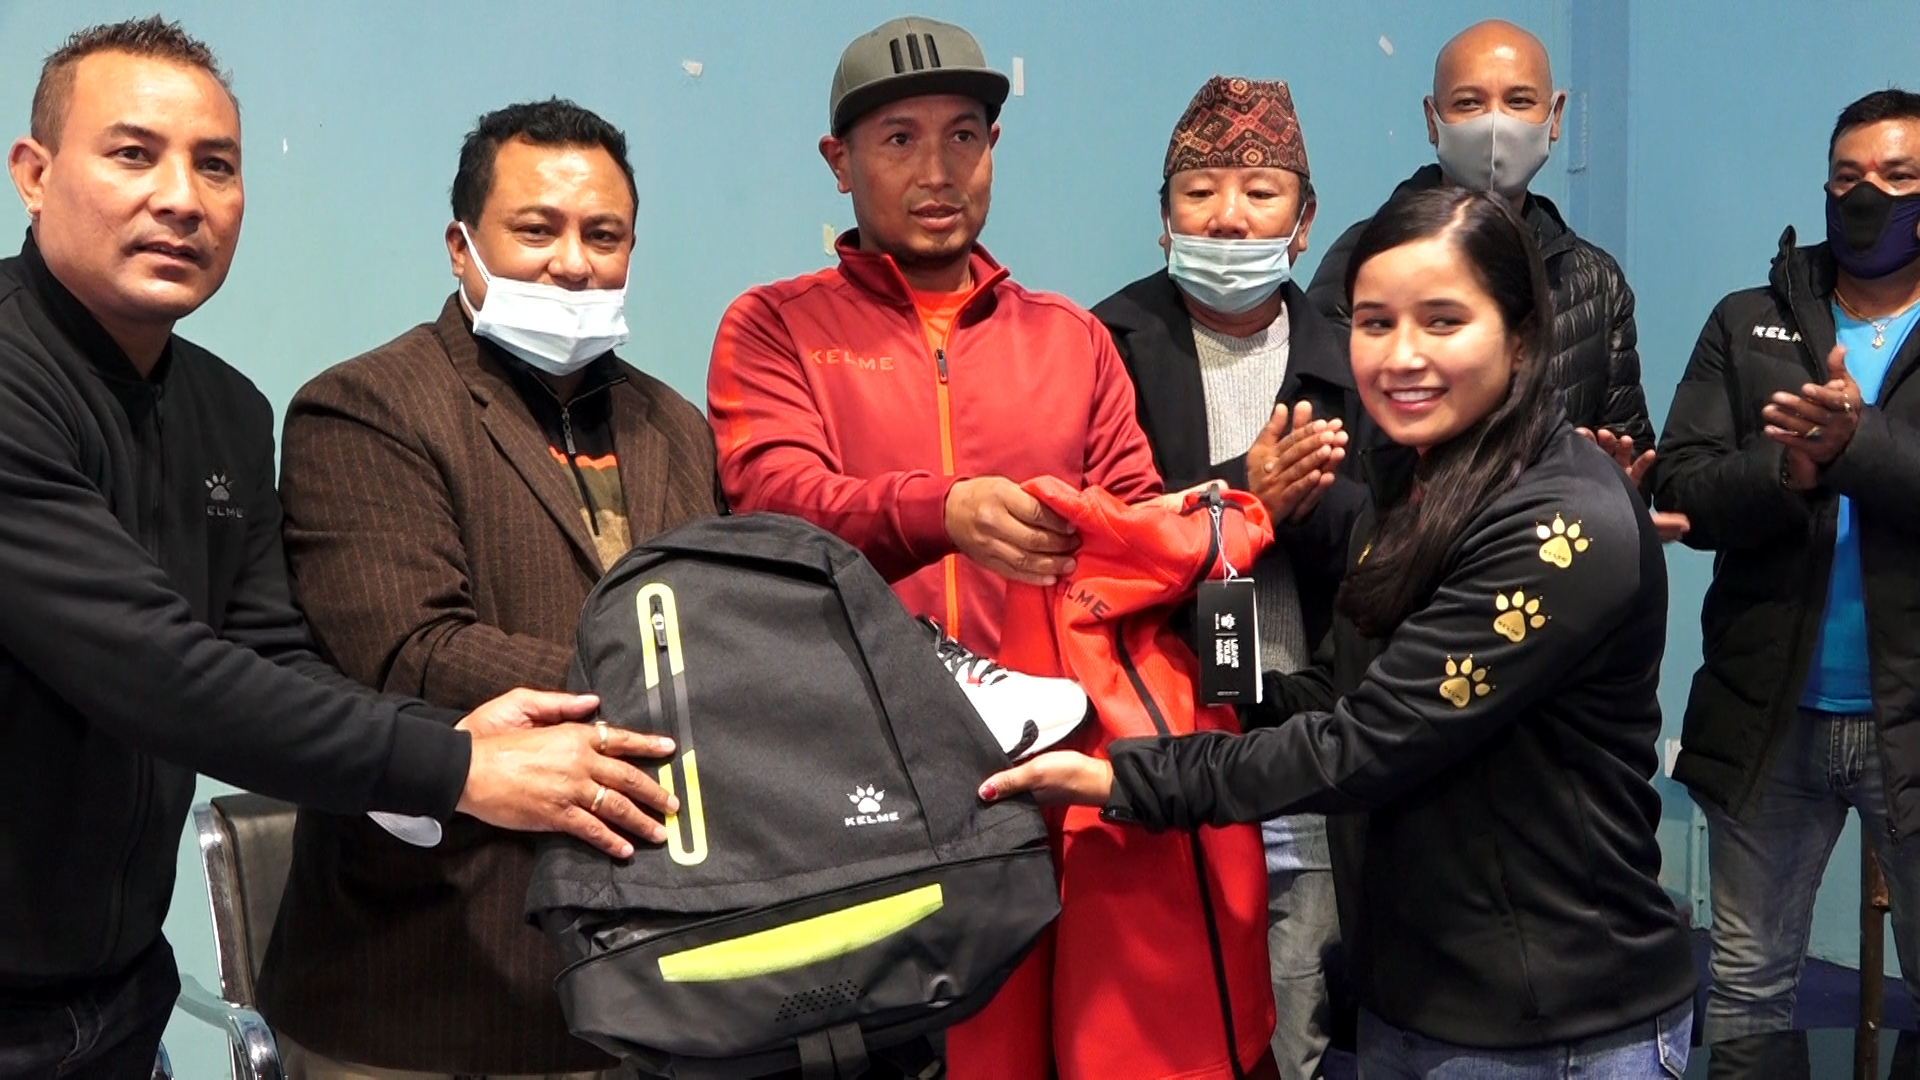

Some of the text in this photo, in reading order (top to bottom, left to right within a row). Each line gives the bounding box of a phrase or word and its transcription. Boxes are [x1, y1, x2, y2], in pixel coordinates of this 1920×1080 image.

[809, 349, 895, 371] KELME
[207, 505, 244, 518] ELME
[1065, 581, 1112, 621] LME
[844, 811, 900, 827] KELME
